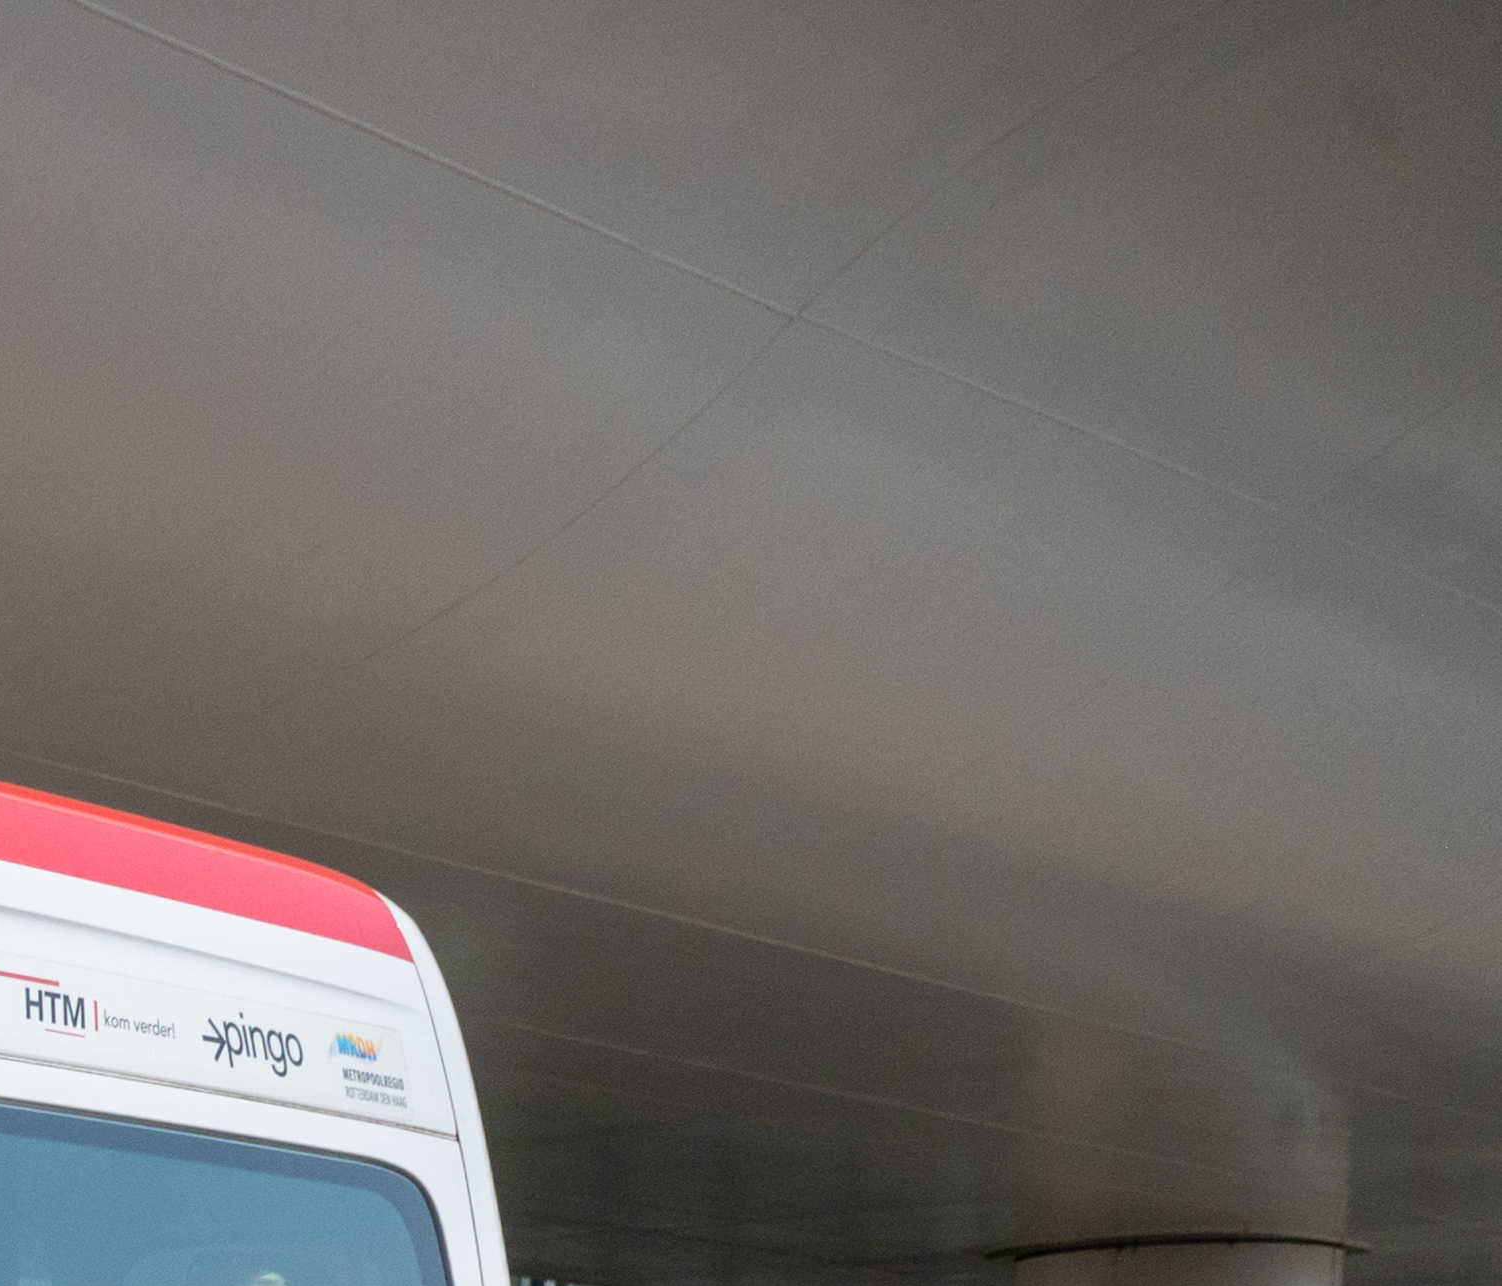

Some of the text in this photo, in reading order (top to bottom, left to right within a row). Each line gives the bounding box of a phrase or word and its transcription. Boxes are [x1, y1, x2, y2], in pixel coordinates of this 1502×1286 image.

[25, 987, 176, 1038] HTM kom verder!
[223, 1012, 303, 1077] pingo
